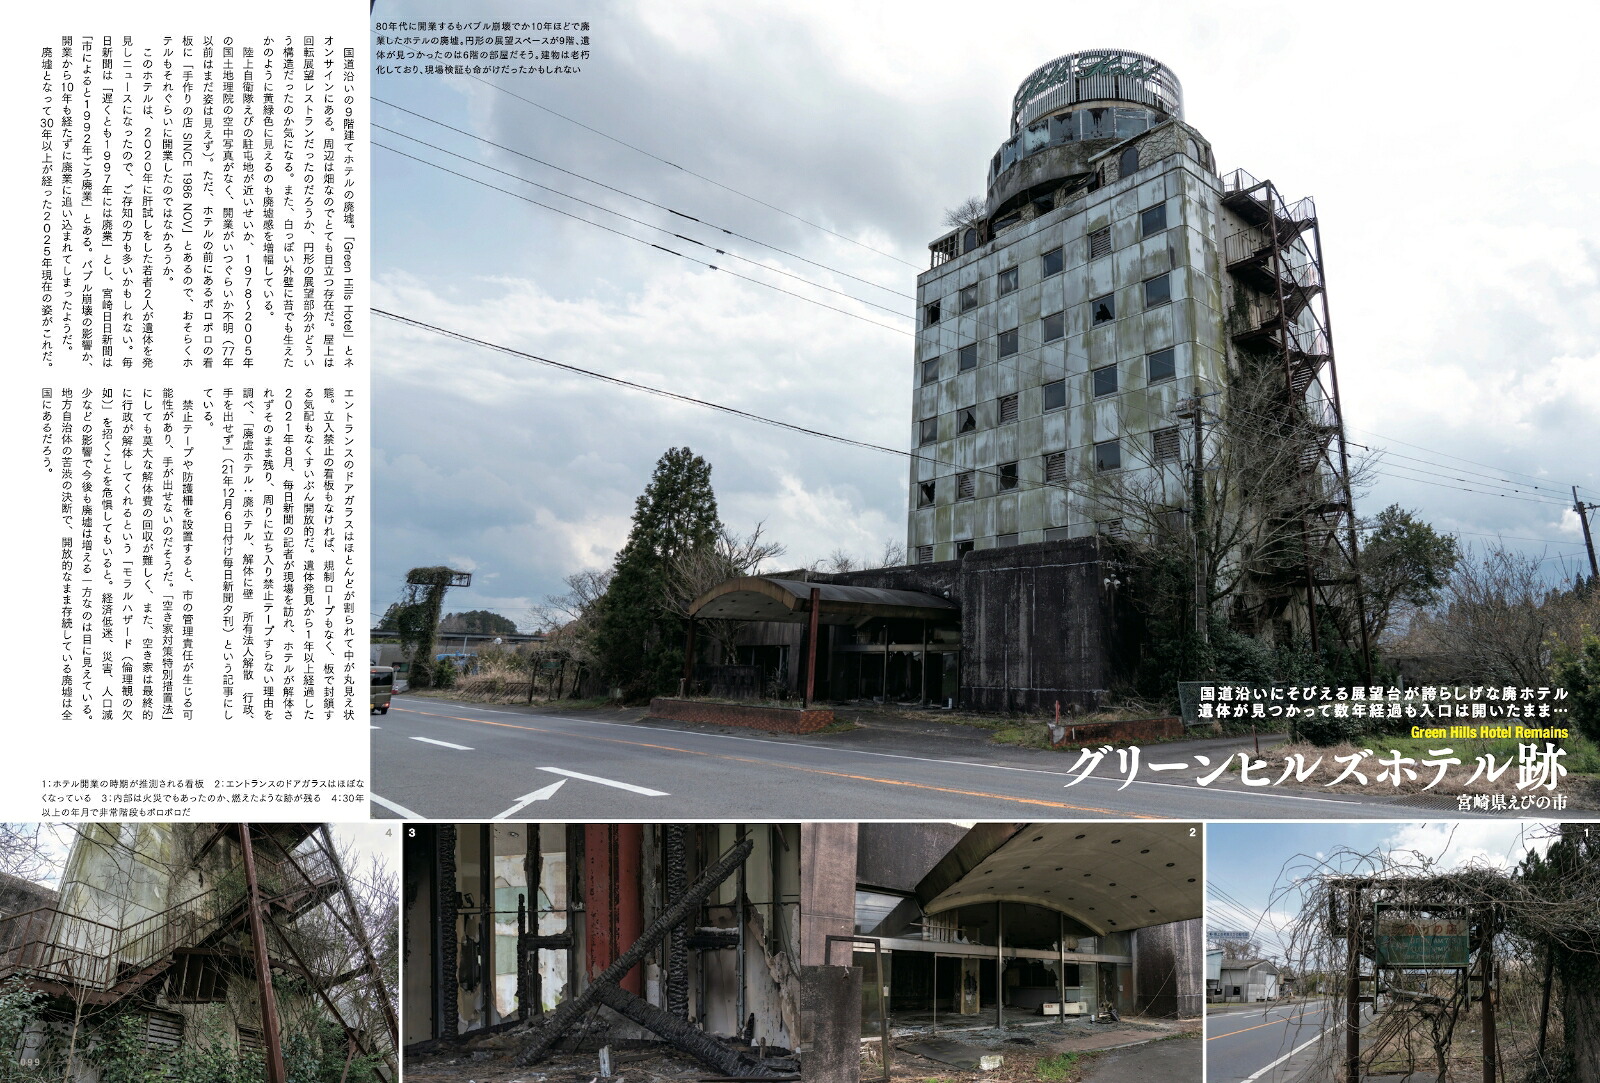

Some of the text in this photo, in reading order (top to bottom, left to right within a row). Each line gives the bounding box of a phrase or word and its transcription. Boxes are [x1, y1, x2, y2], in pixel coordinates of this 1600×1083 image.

[203, 388, 214, 427] ている。
[41, 387, 53, 473] 国にあるだろう。
[42, 793, 92, 803] くなっている
